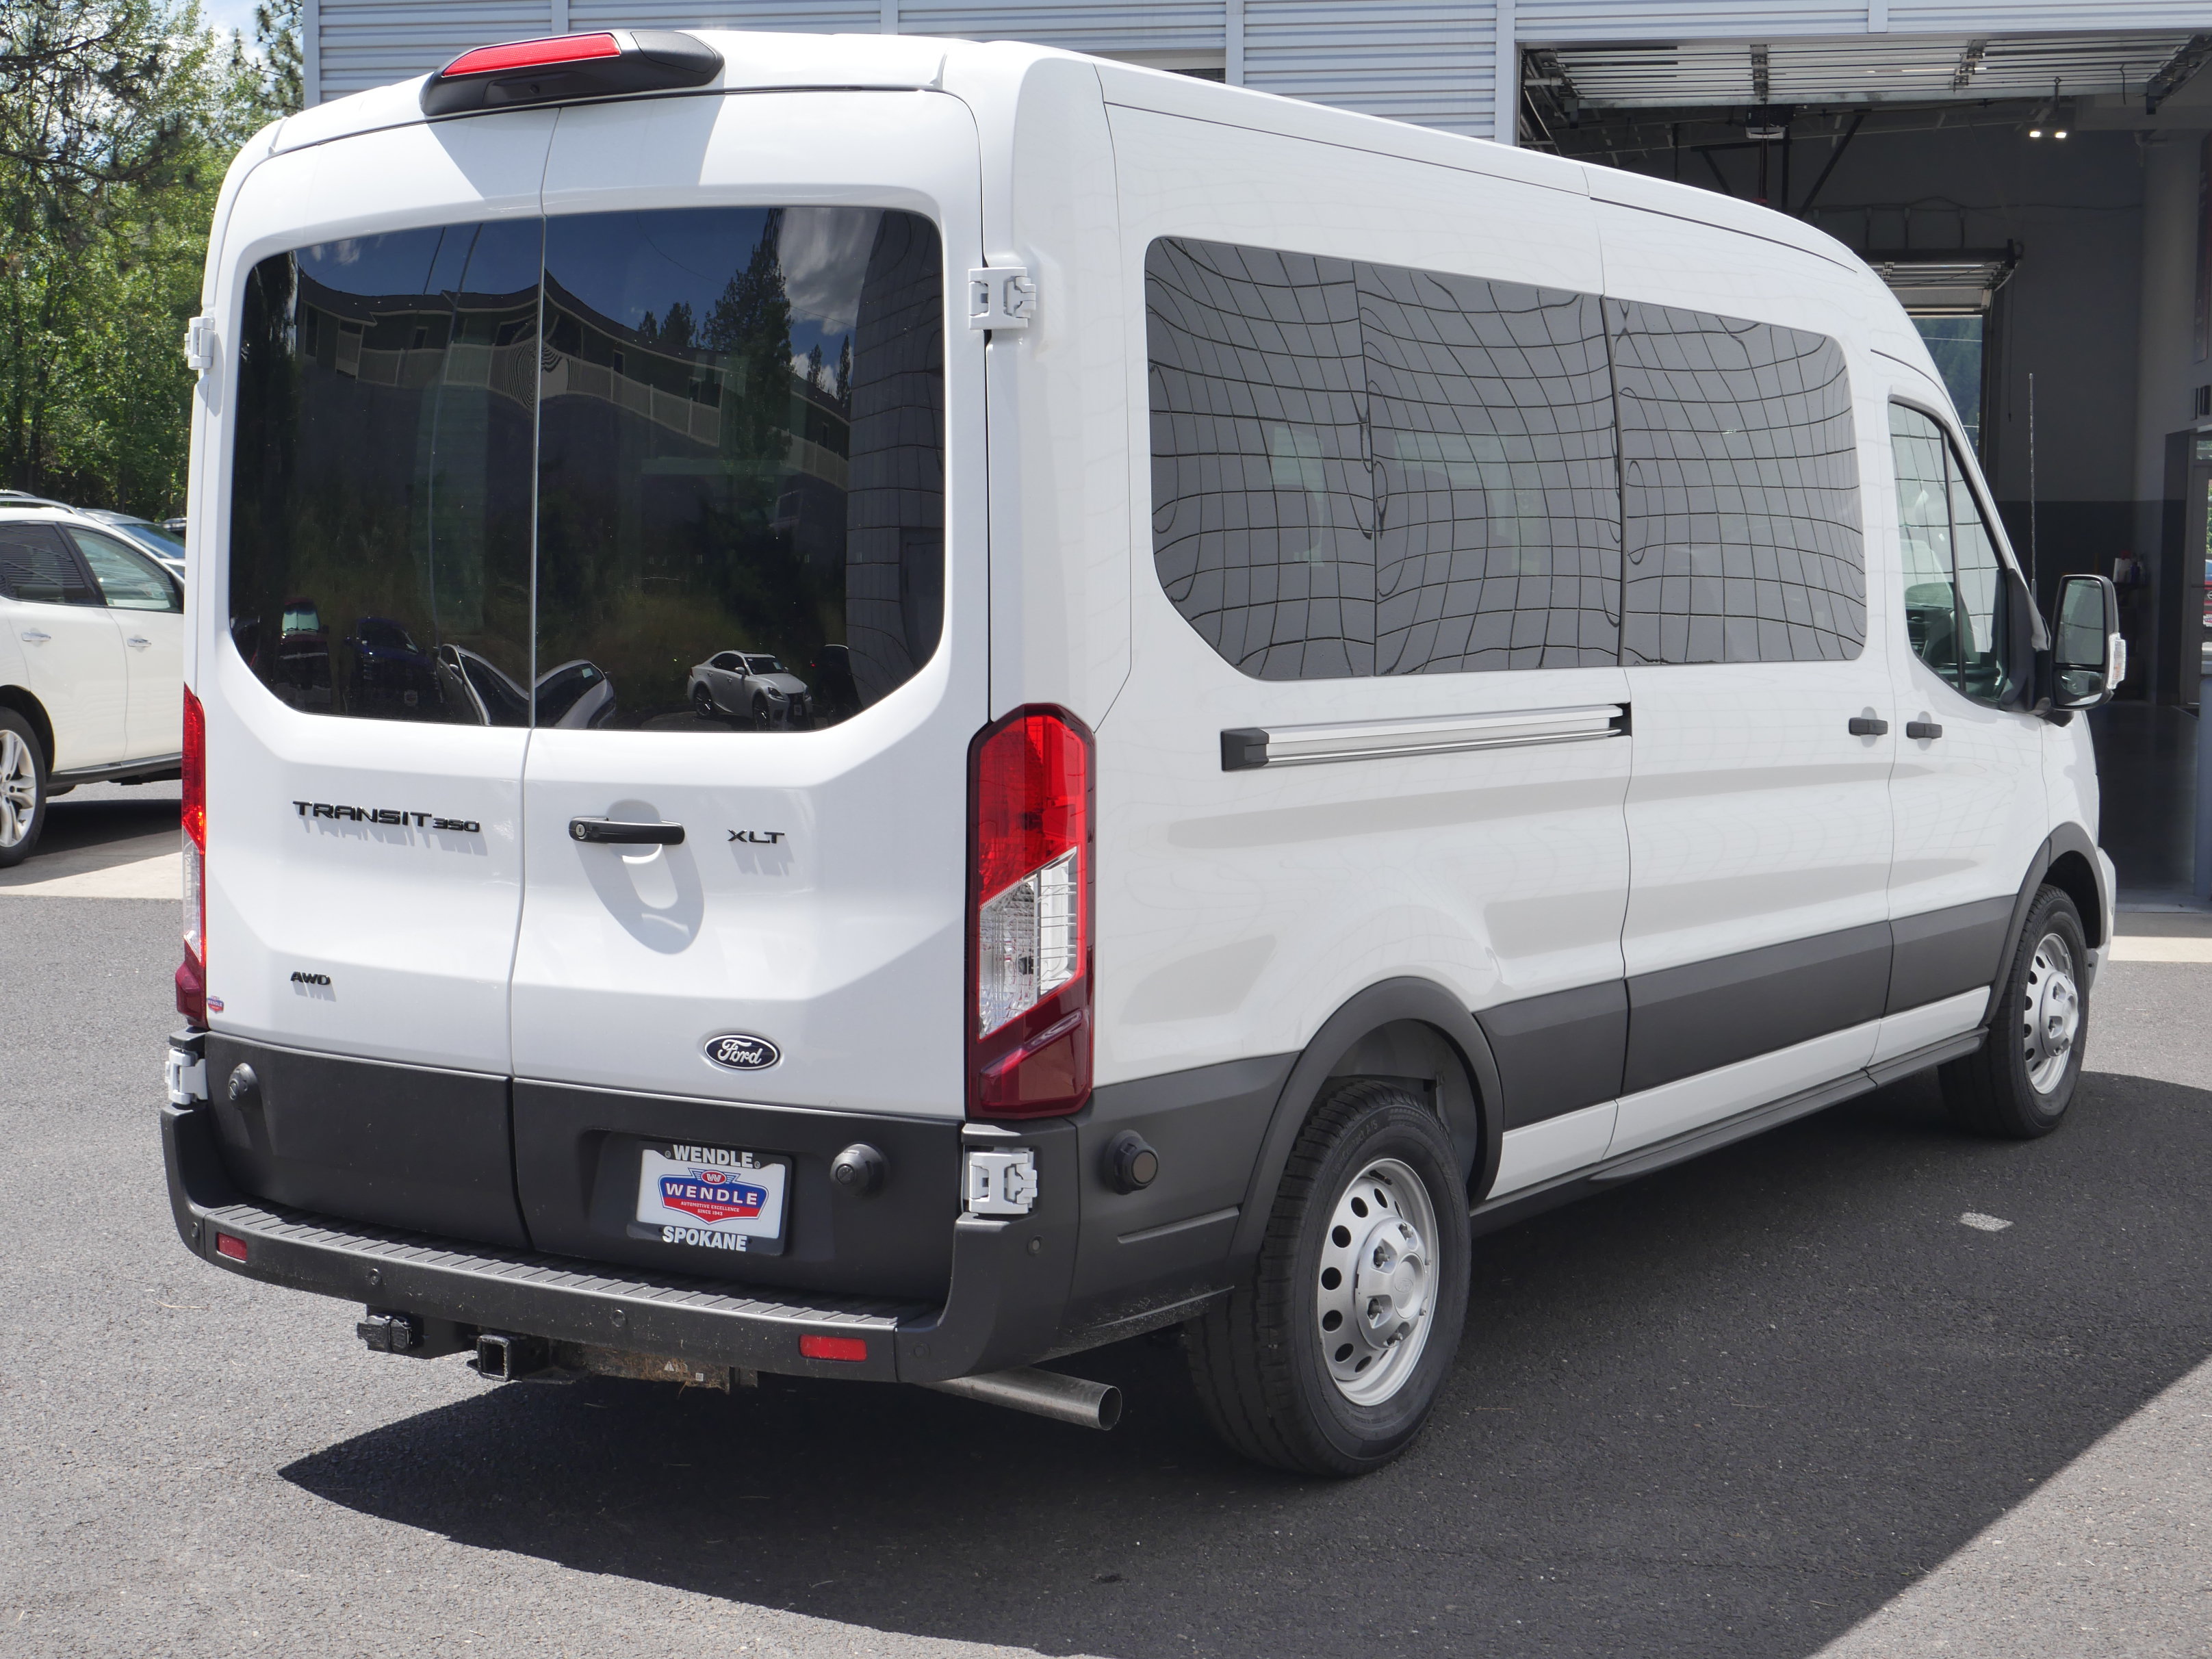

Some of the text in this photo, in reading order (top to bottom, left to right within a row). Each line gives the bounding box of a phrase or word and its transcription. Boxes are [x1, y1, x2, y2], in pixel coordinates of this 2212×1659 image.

[292, 800, 480, 832] TRANSIT 350
[727, 829, 785, 844] XLT
[290, 971, 331, 986] AWD
[717, 1039, 763, 1064] Ford
[673, 1144, 754, 1169] WENDLE
[665, 1182, 758, 1205] WENDLE
[663, 1226, 747, 1252] SPOKANE
